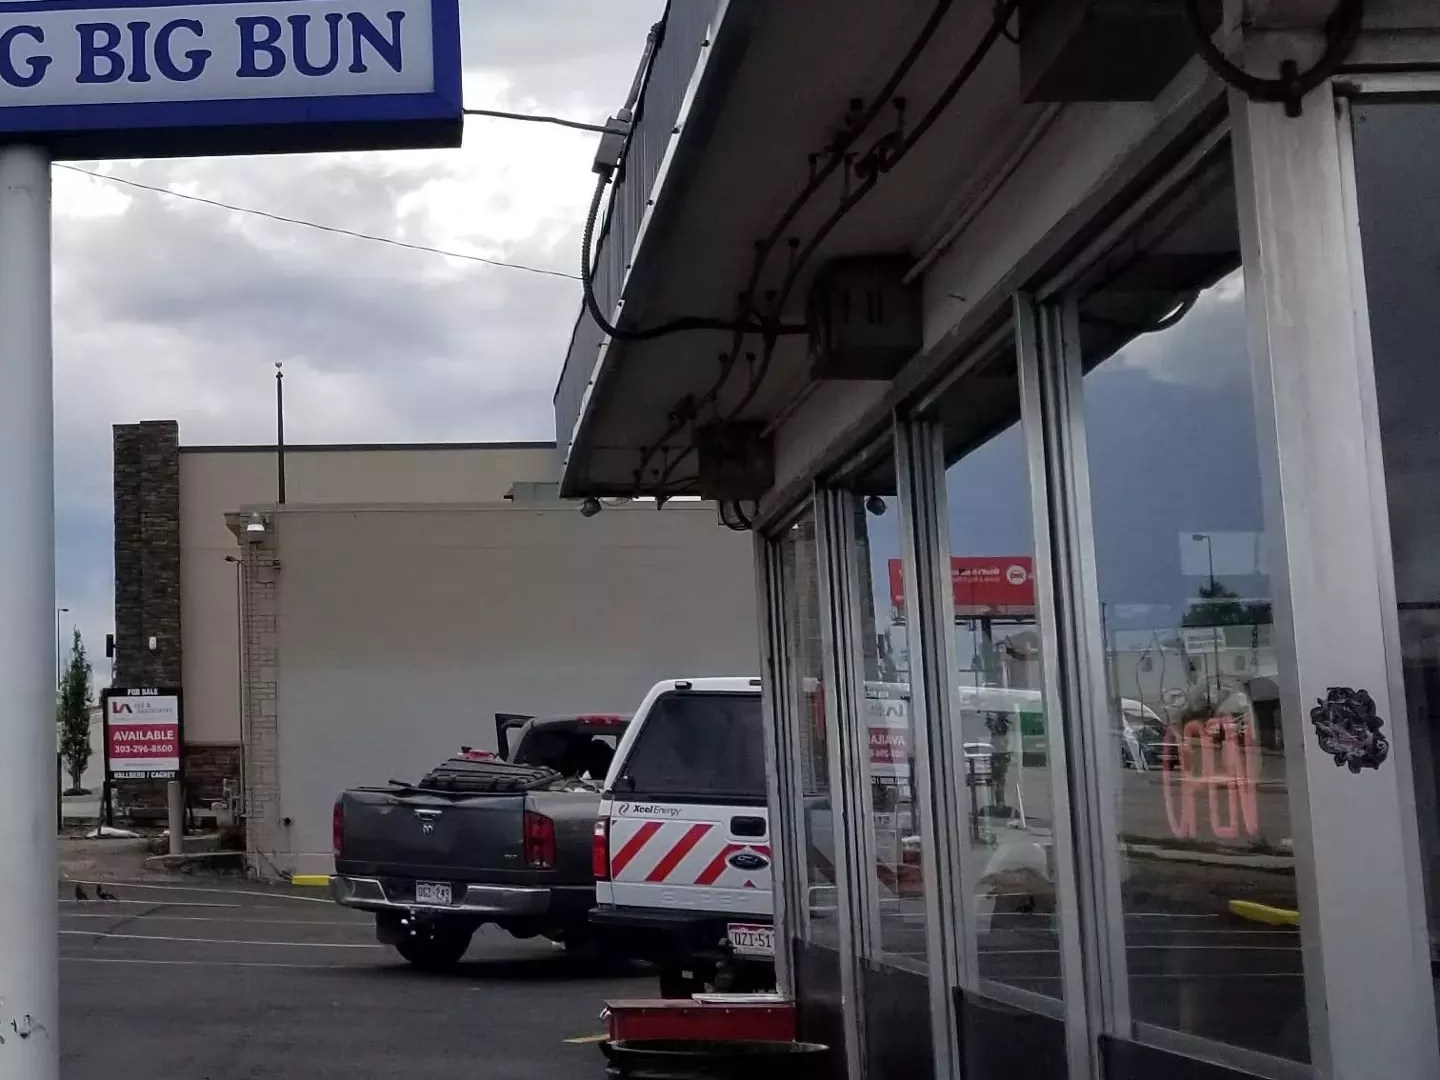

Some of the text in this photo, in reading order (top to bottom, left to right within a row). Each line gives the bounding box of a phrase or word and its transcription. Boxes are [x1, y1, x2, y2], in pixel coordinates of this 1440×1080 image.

[75, 19, 212, 83] BIG
[235, 11, 405, 77] BUN
[127, 688, 140, 696] FOR
[113, 730, 175, 741] AVAILABLE
